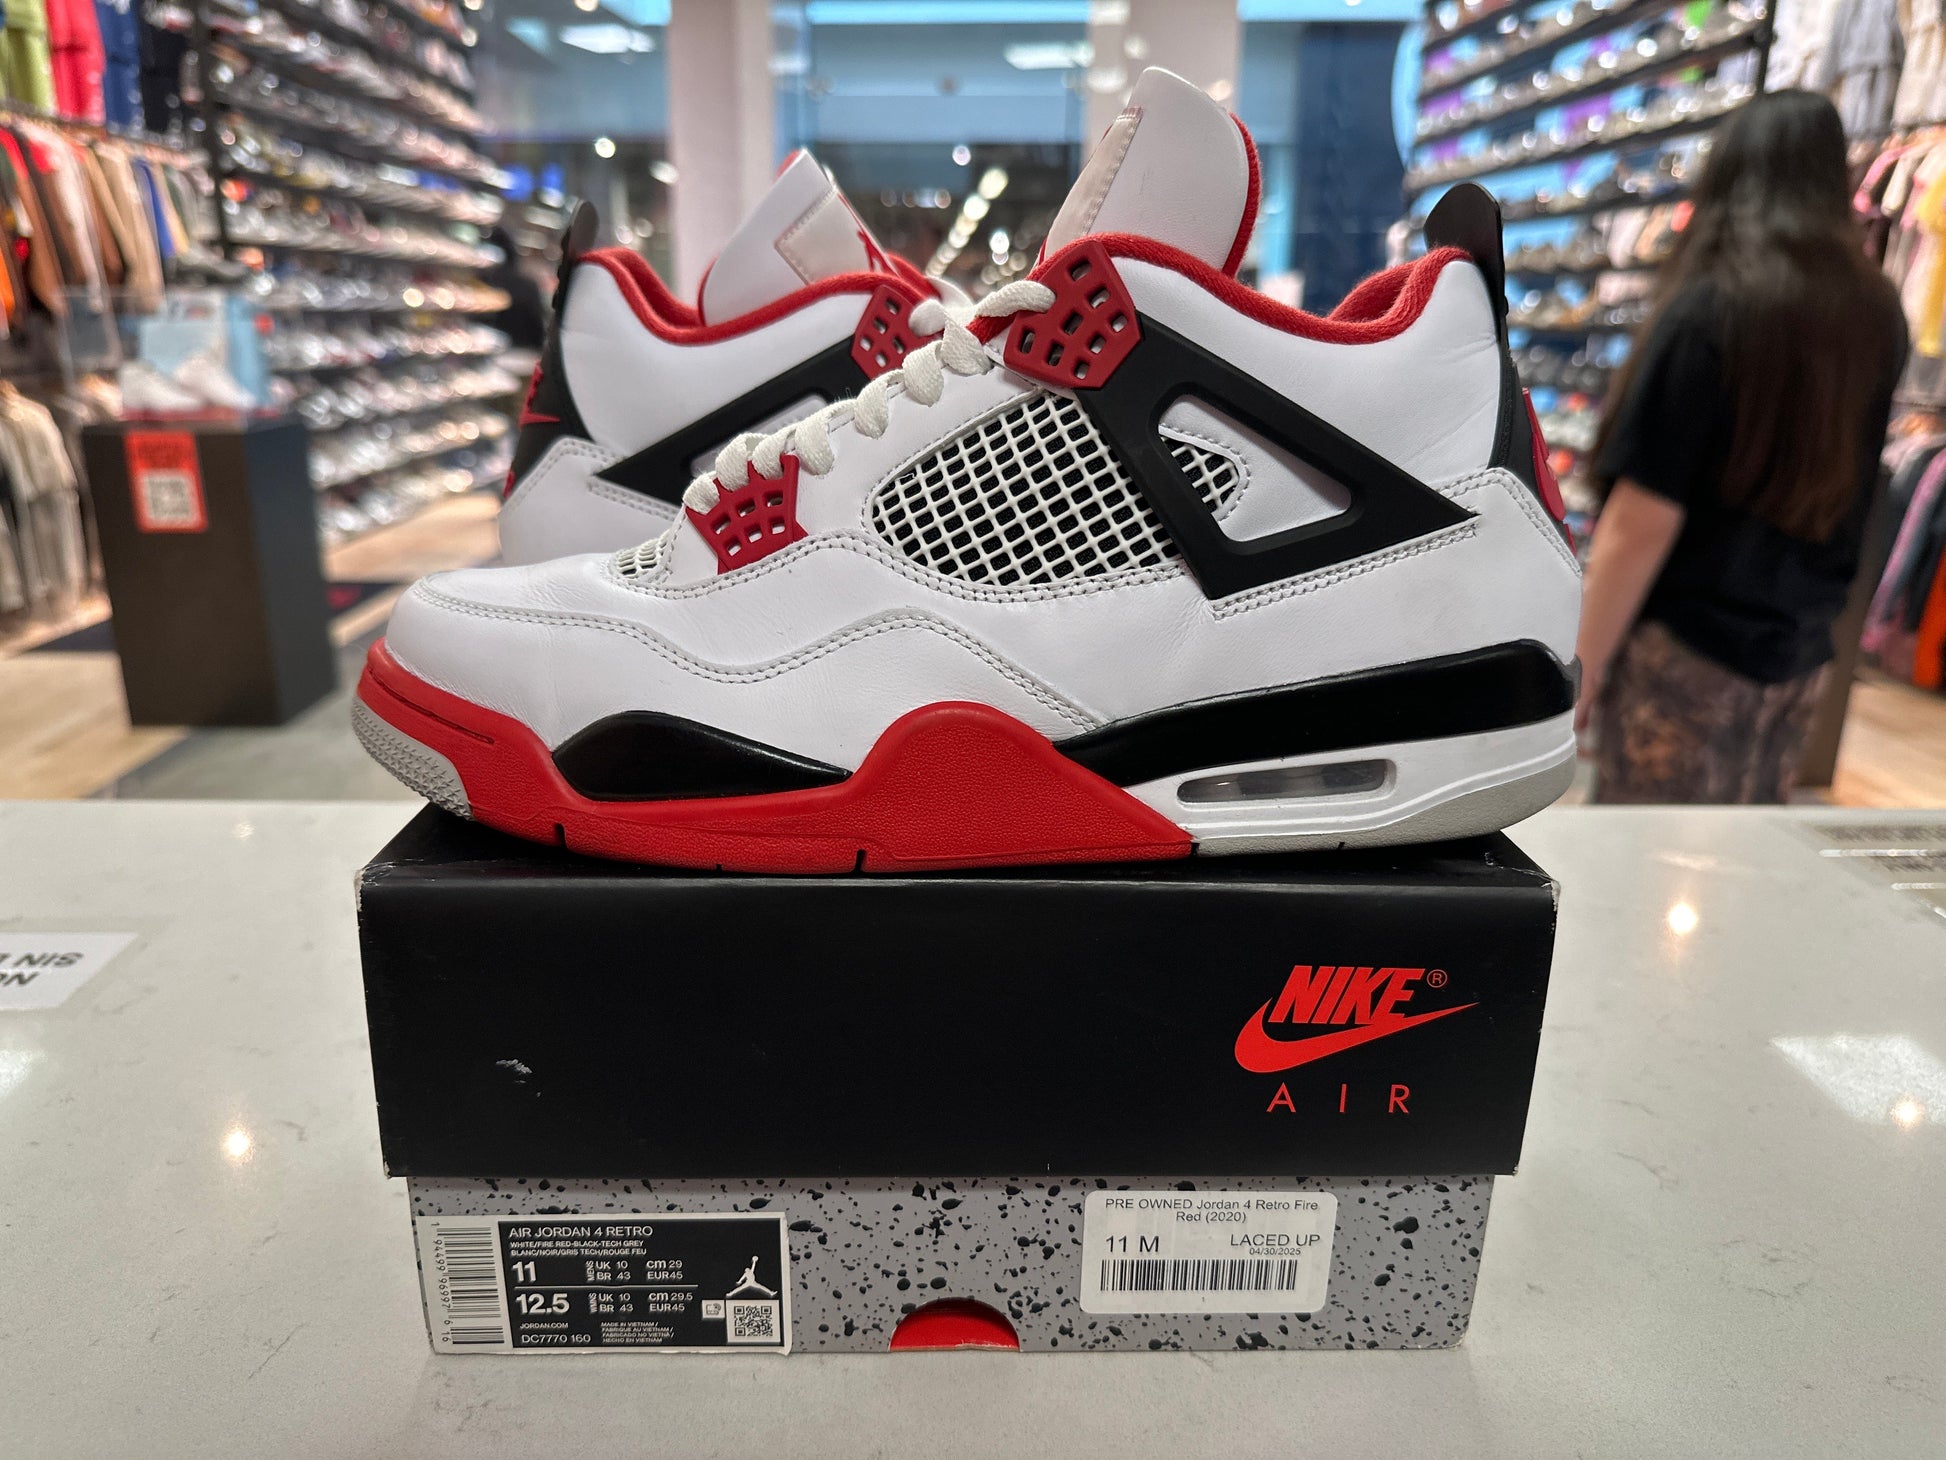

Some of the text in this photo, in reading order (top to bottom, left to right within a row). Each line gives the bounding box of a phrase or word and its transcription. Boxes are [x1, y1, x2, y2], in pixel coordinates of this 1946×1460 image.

[1267, 965, 1426, 1025] NIKE
[1105, 1198, 1319, 1211] PRE OWNED Jordan 4 Retro Fire
[1176, 1211, 1247, 1223] Red (2020)
[509, 1225, 653, 1238] AIR JORDAN 4 RETRO
[510, 1240, 554, 1248] WHITE/FIRE
[1105, 1235, 1160, 1253] 11 M
[1230, 1234, 1321, 1246] LACED UP
[433, 1239, 446, 1271] 94499
[1249, 1247, 1301, 1256] 04/30/2025
[596, 1260, 629, 1270] UK 10
[646, 1260, 683, 1269] cm 29
[512, 1261, 537, 1283] 11
[597, 1271, 631, 1280] BR 43
[439, 1278, 450, 1309] 96997
[599, 1292, 631, 1302] UK 10
[649, 1292, 693, 1301] cm 29.5
[515, 1292, 570, 1315] 12.5
[599, 1303, 634, 1313] BR 43
[519, 1322, 569, 1330] JORDAN.COM
[521, 1334, 592, 1344] DC7770 160
